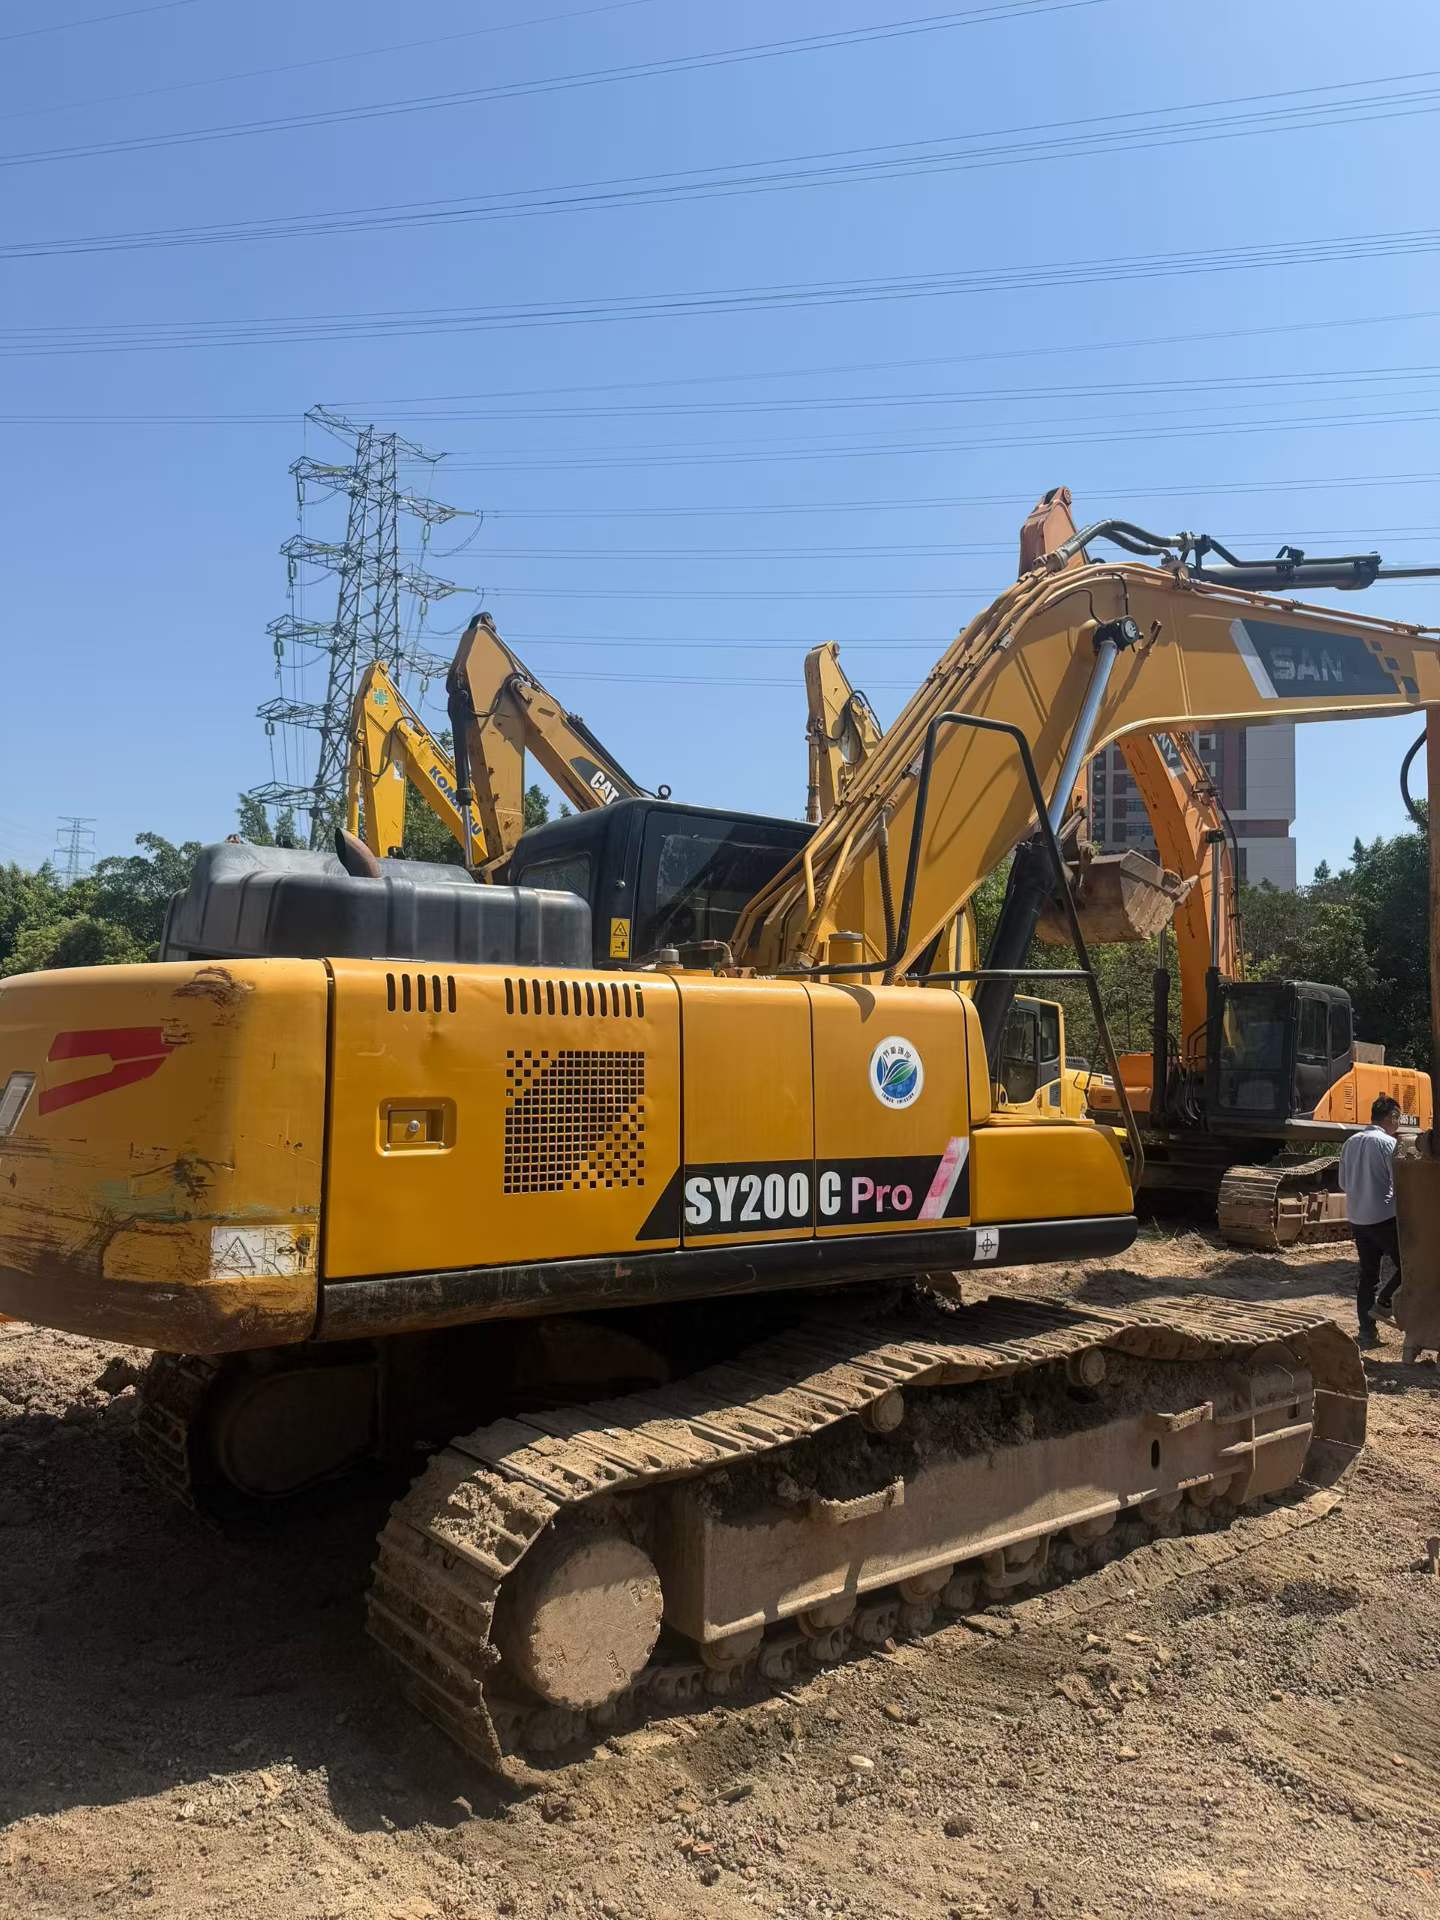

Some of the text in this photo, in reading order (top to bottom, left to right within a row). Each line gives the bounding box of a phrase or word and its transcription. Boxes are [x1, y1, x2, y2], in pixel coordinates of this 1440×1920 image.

[429, 765, 482, 836] KOMU
[590, 770, 620, 805] CAT
[851, 1176, 913, 1214] Pro
